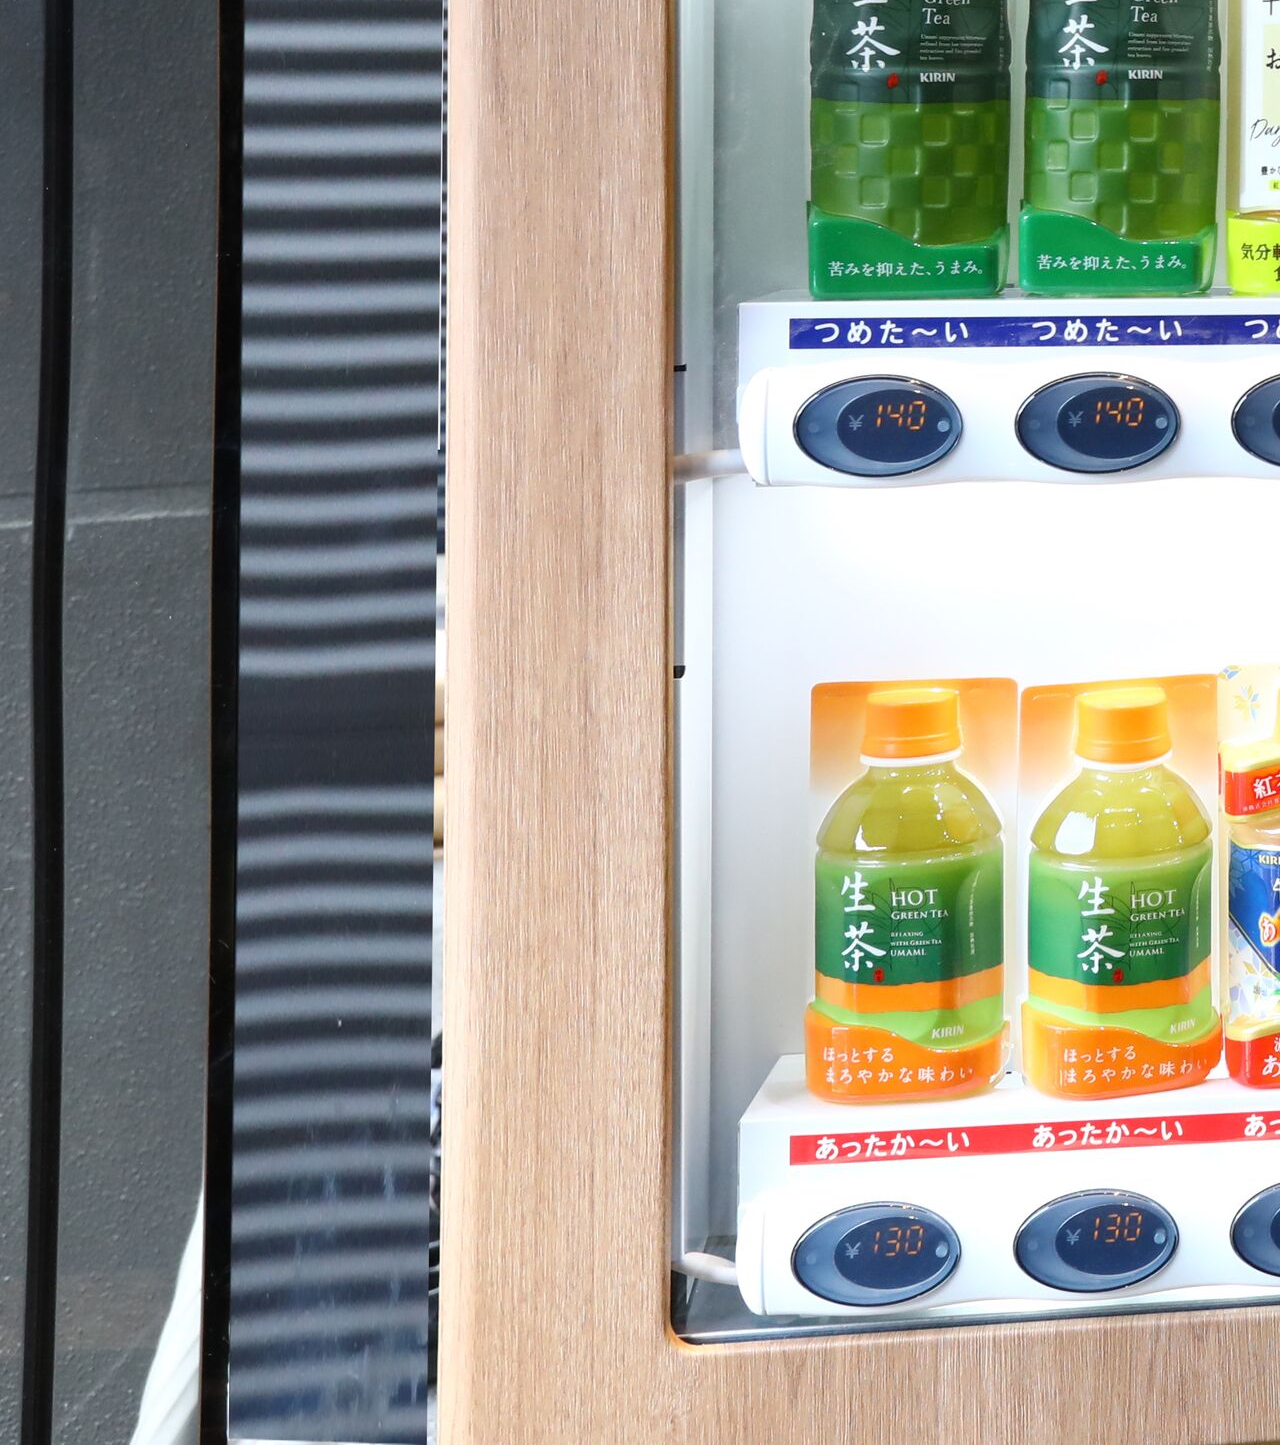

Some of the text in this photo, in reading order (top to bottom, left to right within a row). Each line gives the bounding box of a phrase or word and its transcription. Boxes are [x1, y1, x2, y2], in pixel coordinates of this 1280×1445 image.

[922, 8, 951, 25] Tea
[920, 72, 955, 83] KIRIN
[875, 401, 927, 430] 140
[891, 889, 937, 907] HOT
[840, 872, 886, 973] 生茶
[931, 1025, 964, 1039] KIRIN
[872, 1226, 924, 1256] 130
